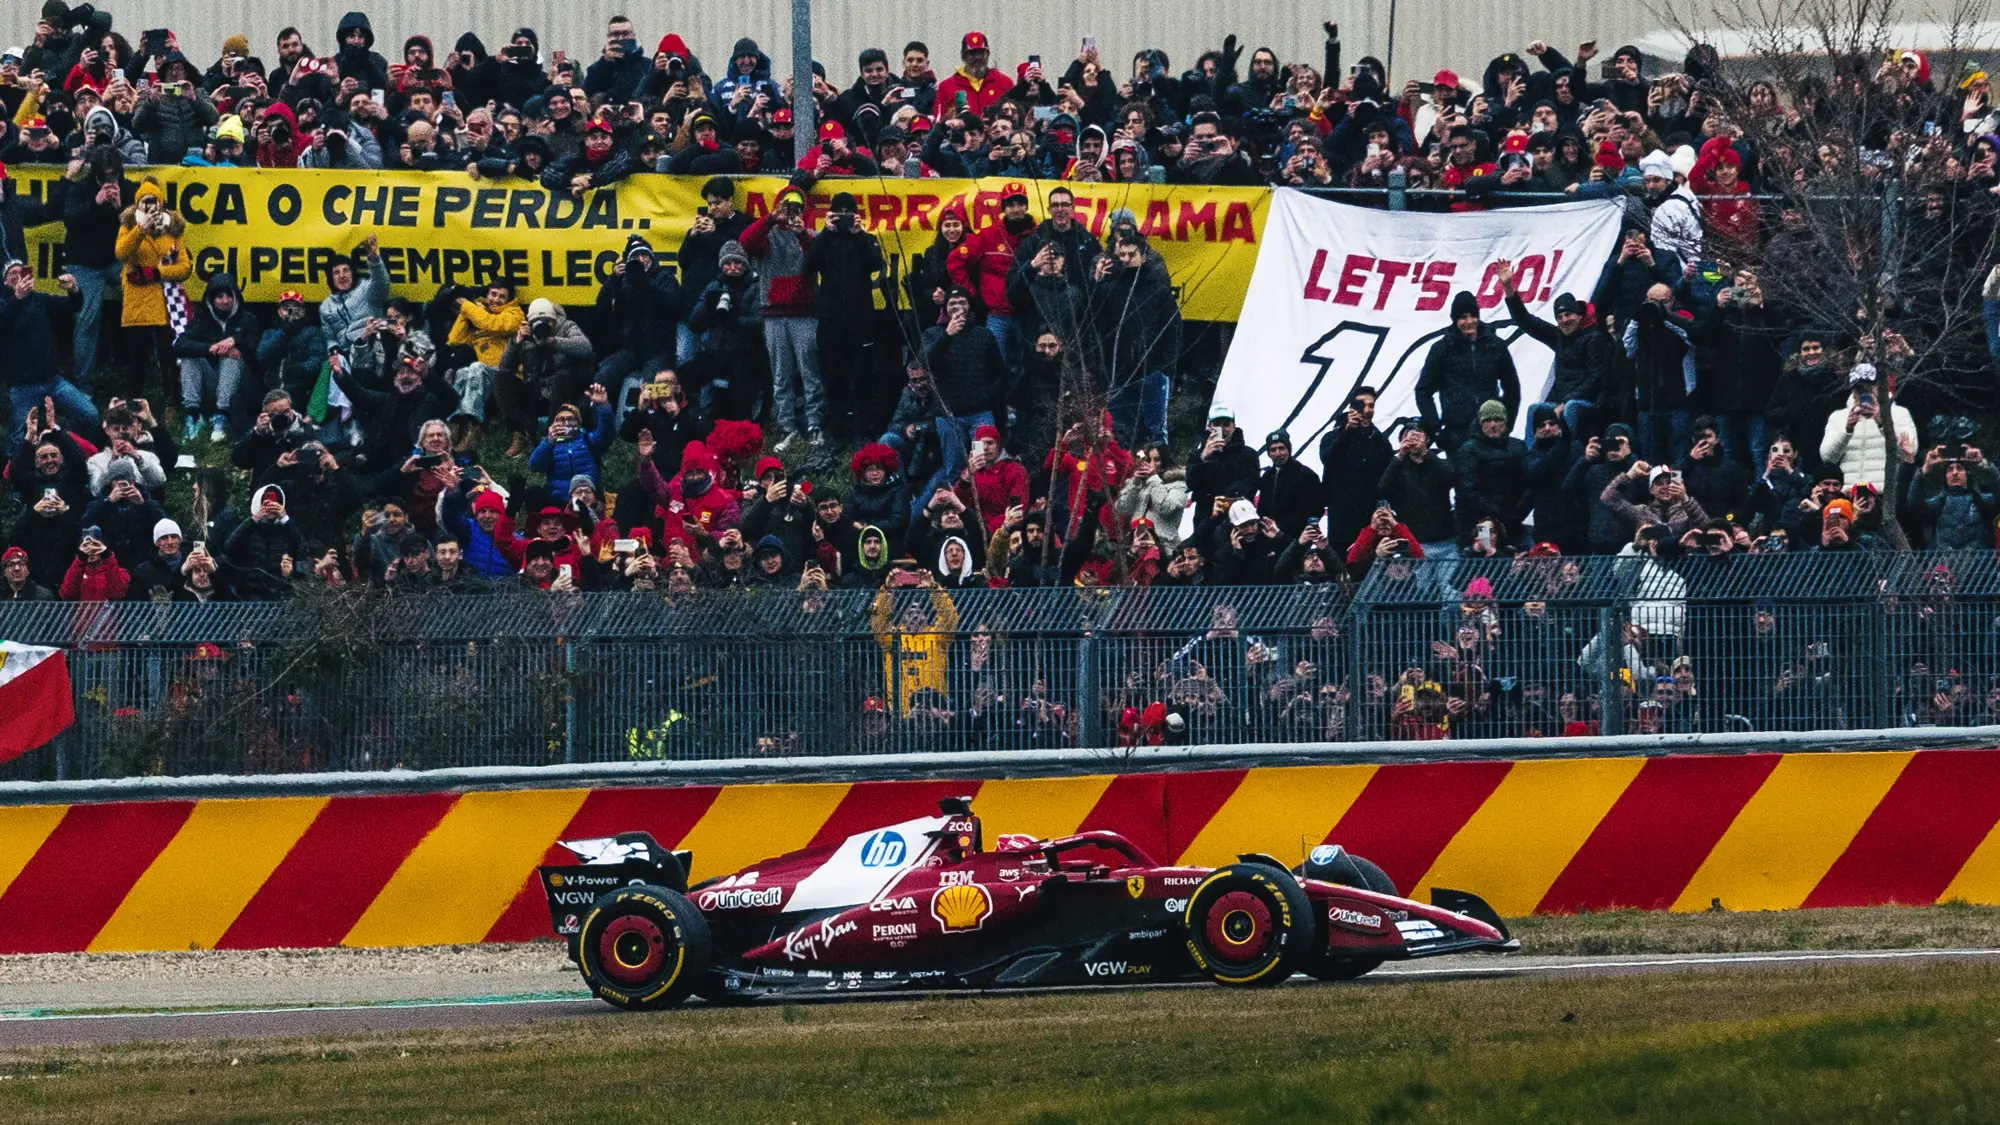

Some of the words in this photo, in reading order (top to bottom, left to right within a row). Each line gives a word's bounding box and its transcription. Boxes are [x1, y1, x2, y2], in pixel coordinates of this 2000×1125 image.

[267, 184, 302, 226] O
[322, 184, 420, 228] CHE
[1138, 200, 1256, 244] AMA
[1303, 249, 1458, 312] LET'S
[1476, 249, 1564, 309] GO!
[861, 831, 906, 867] hp
[564, 875, 619, 886] V-Power
[939, 870, 975, 886] IBM
[555, 891, 595, 905] VGW
[717, 887, 781, 908] UniCredit
[1340, 910, 1381, 928] UniCredit
[872, 922, 918, 937] PERONI
[843, 970, 863, 980] NOK
[1084, 961, 1128, 976] VGW
[1127, 965, 1152, 974] PLAY
